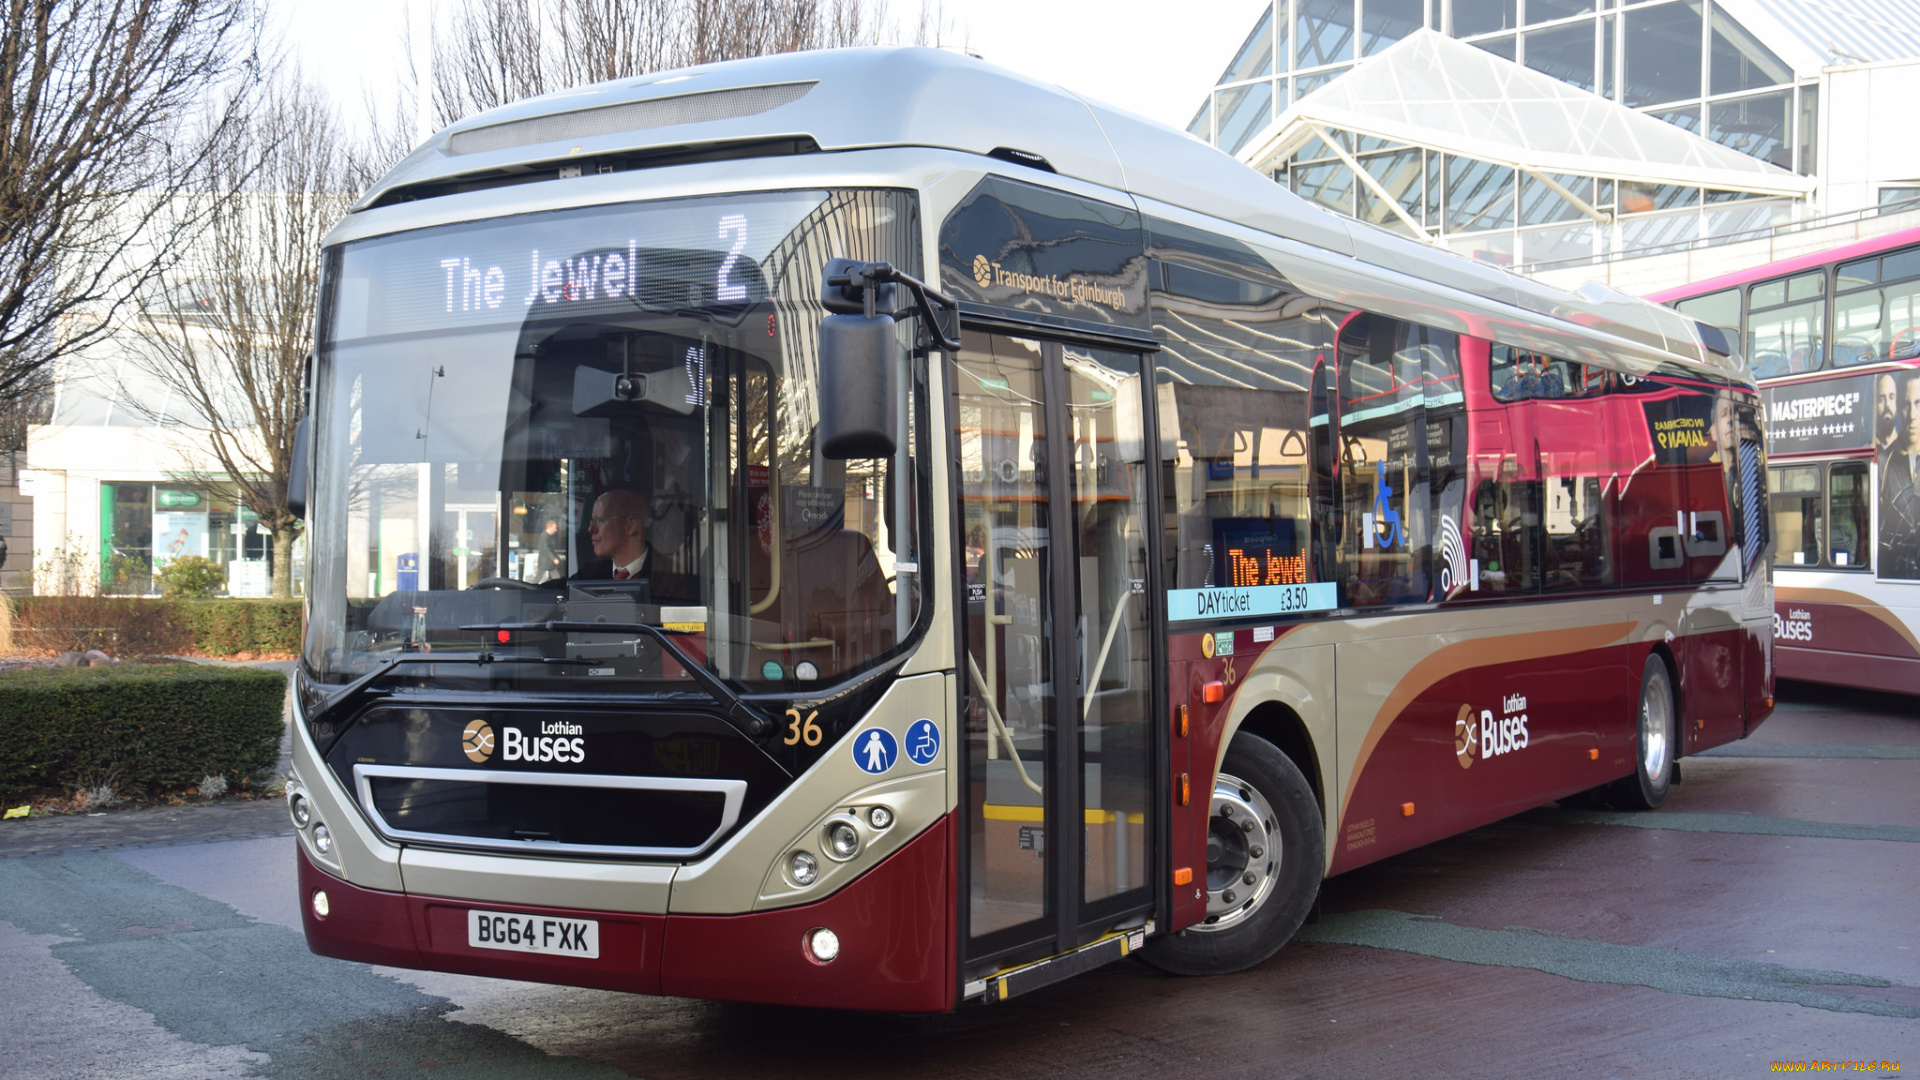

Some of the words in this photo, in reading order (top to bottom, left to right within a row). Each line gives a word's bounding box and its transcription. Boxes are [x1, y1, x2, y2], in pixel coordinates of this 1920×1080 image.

[440, 257, 505, 312] The
[525, 240, 637, 306] Jewel
[717, 213, 748, 301] 2
[991, 262, 1052, 295] Transport
[1052, 274, 1069, 298] for
[1070, 278, 1126, 311] Edinburgh
[1229, 548, 1260, 587] The
[1265, 548, 1307, 585] Jewel
[1281, 587, 1308, 611] £3.50
[1789, 608, 1811, 621] Lothian
[1773, 614, 1812, 641] Buses
[1222, 657, 1236, 686] 36
[1503, 692, 1527, 715] Lothian
[502, 727, 585, 763] Buses
[541, 720, 583, 736] Lothian
[783, 709, 823, 747] 36
[1481, 709, 1529, 760] Buses
[478, 915, 535, 946] BG64
[543, 920, 588, 951] FXK
